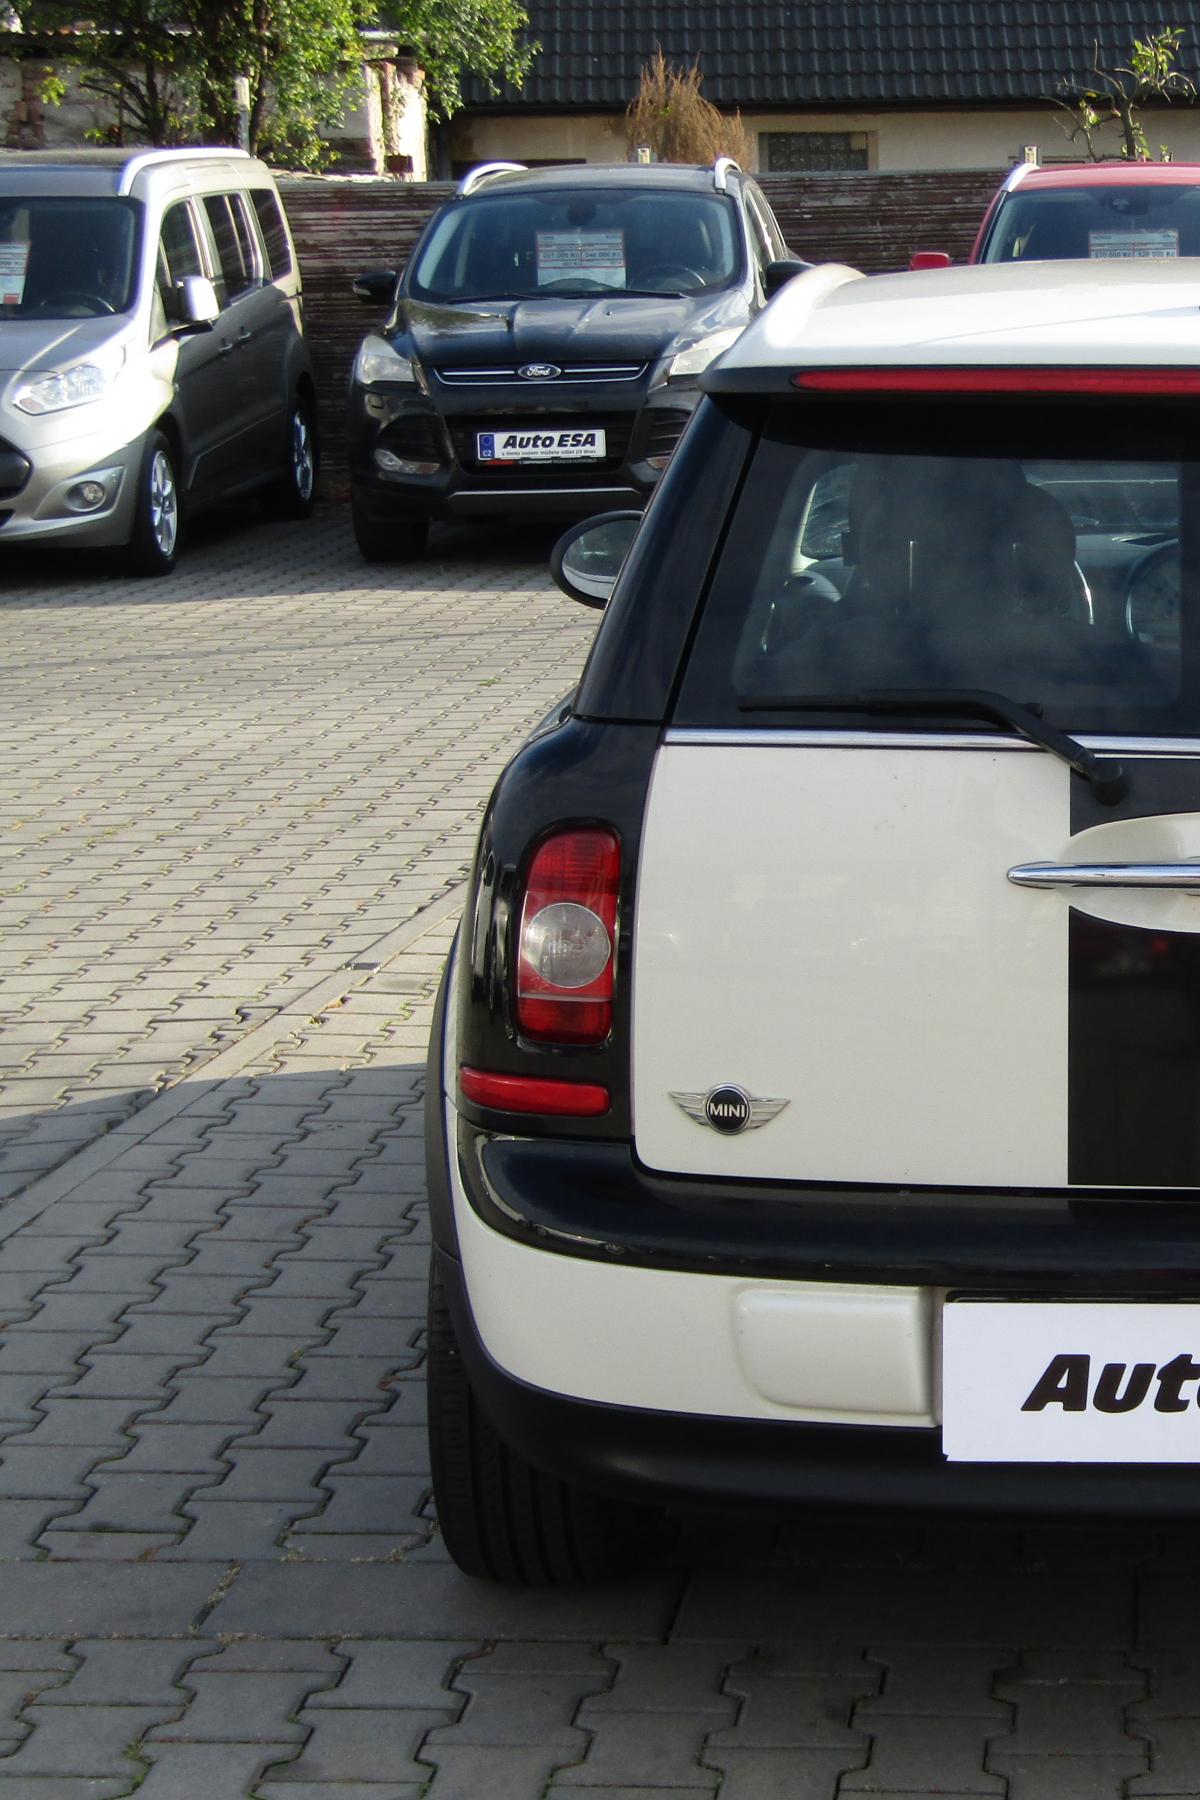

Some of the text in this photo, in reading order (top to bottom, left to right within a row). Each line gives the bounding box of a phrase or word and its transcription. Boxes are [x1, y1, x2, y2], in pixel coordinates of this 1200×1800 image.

[527, 365, 551, 377] Ford
[503, 433, 596, 449] Auto ESA
[710, 1102, 745, 1118] MINI
